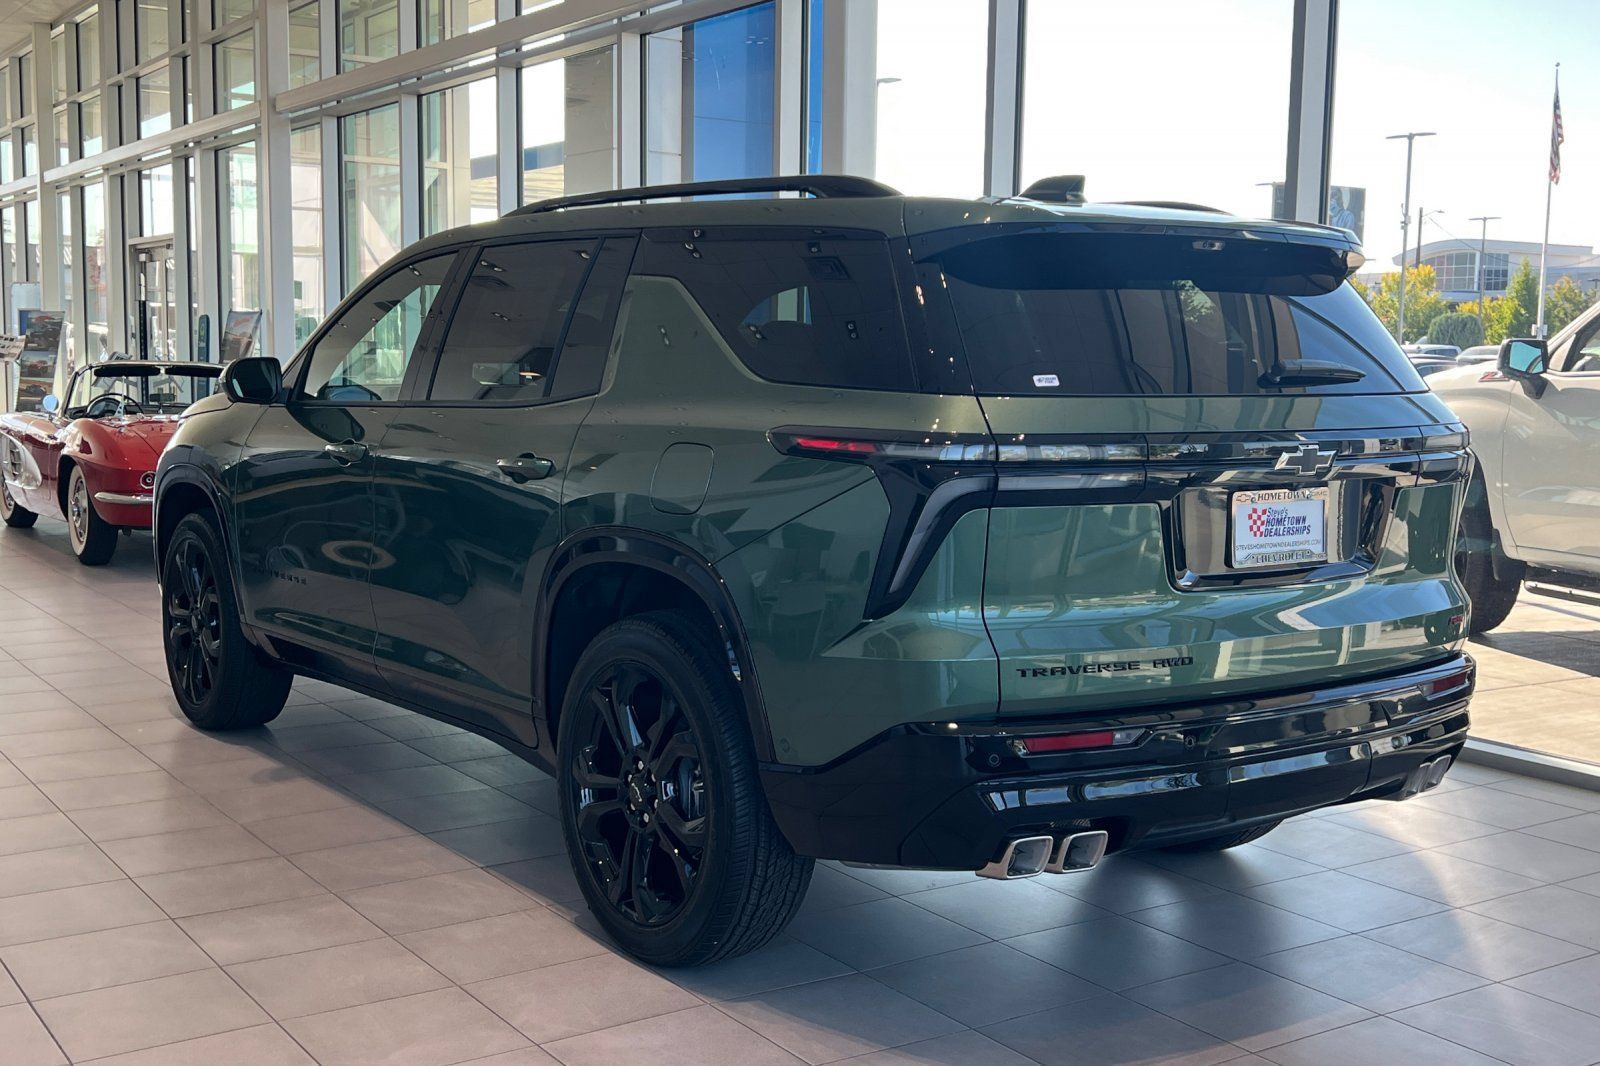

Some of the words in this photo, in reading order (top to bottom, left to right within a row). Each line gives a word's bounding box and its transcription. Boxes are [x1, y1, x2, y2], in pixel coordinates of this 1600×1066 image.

[1257, 490, 1308, 502] HOMETOWN
[1267, 507, 1289, 517] Steve's
[1265, 515, 1307, 527] HOMETOWN
[1264, 525, 1312, 538] DEALERSHIPS
[1016, 661, 1140, 678] TRAVERSE
[1153, 656, 1193, 669] AWD
